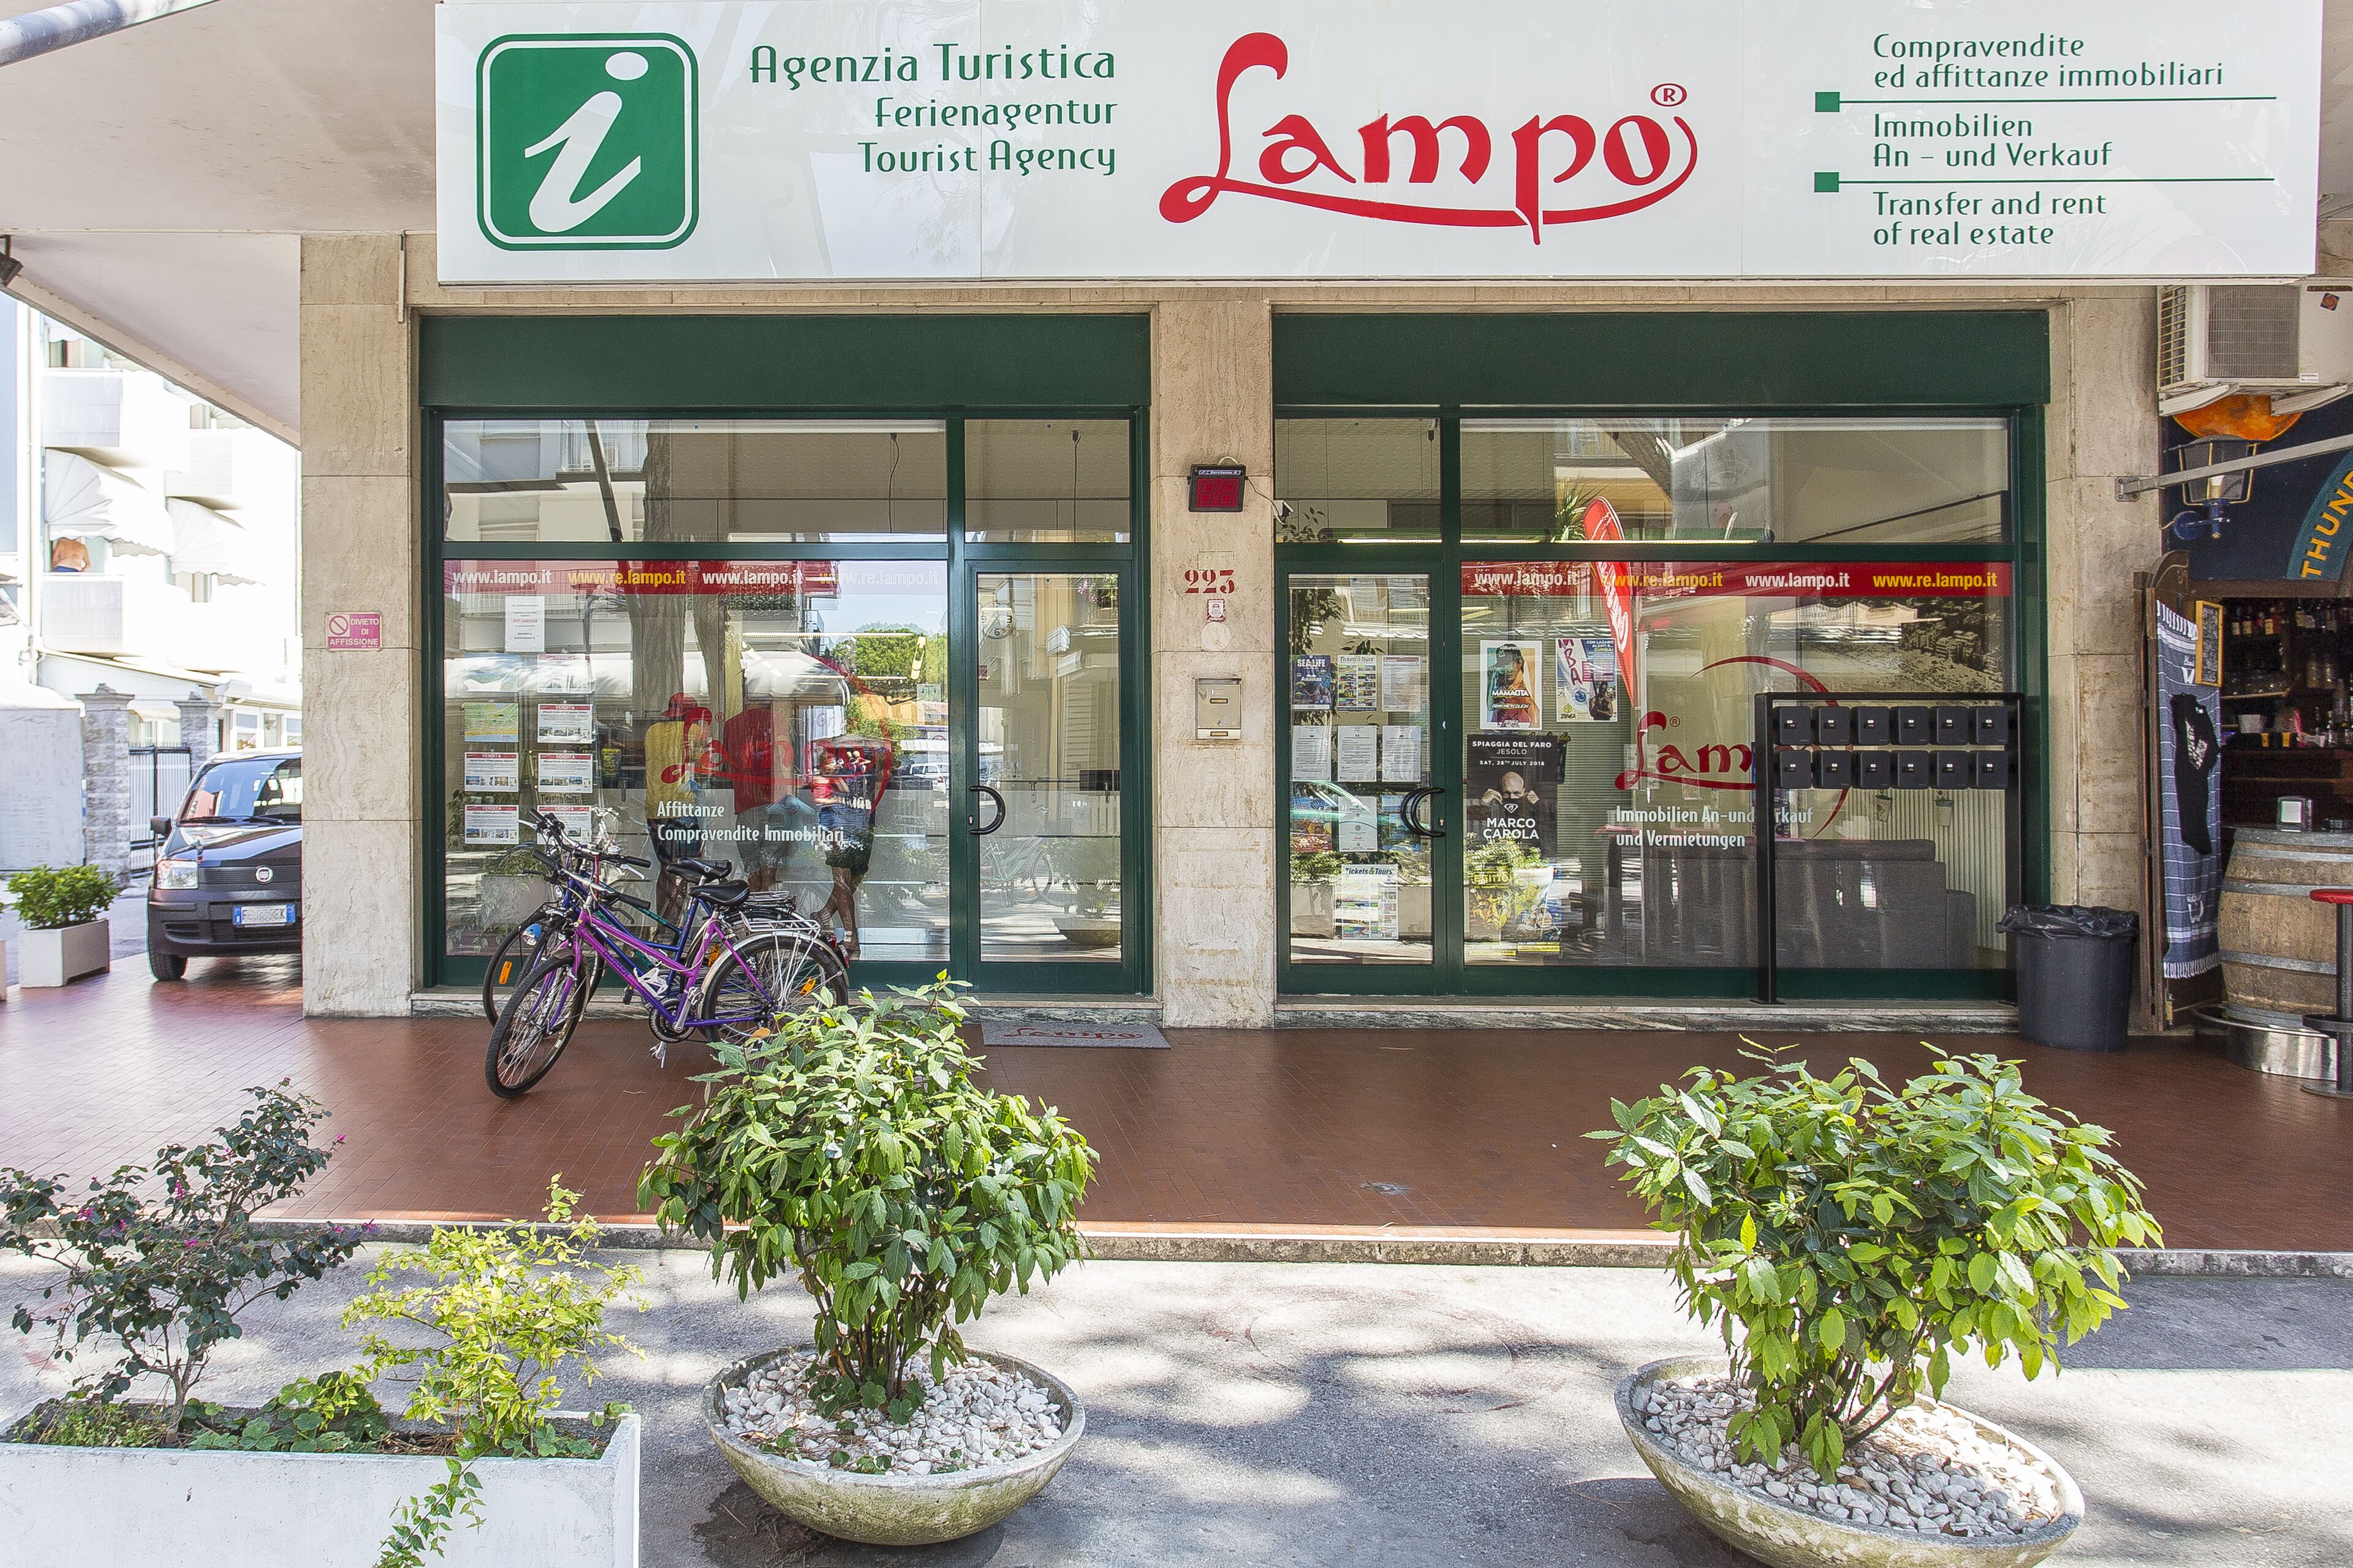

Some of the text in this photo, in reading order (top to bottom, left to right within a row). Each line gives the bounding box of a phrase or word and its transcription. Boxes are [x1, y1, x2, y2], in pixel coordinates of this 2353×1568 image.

[1873, 33, 2085, 62] Compravendite
[751, 43, 1115, 90] Agenzia Turistica
[1874, 62, 2223, 88] ed affittanze immobiliari
[876, 96, 1117, 131] Ferienagentur
[1874, 114, 2033, 138] Immobilien
[858, 141, 1116, 176] Tourist Agency
[1873, 143, 1909, 167] An
[1946, 144, 1996, 167] und
[2006, 142, 2113, 167] Verkauf
[1873, 191, 2108, 216] Transfer and rent
[1873, 221, 2055, 246] of real estate
[453, 569, 551, 586] www.lampo.it
[568, 569, 686, 586] www.re.lampo.it
[702, 570, 803, 587] www.lampo.it
[1184, 569, 1235, 594] 223
[1474, 570, 1578, 588] www.lampo.it
[1745, 572, 1849, 589] www.lampo.it
[1873, 572, 1997, 589] www.re.lampo.it
[657, 801, 724, 817] Affittanze
[1616, 806, 1698, 822] Immobilien
[1775, 806, 1813, 823] rkauf
[657, 824, 844, 844] Compravendite Immobiliari
[1483, 829, 1539, 839] CAROLA
[1487, 818, 1536, 828] MARCO
[1616, 831, 1745, 850] und Vermietungen
